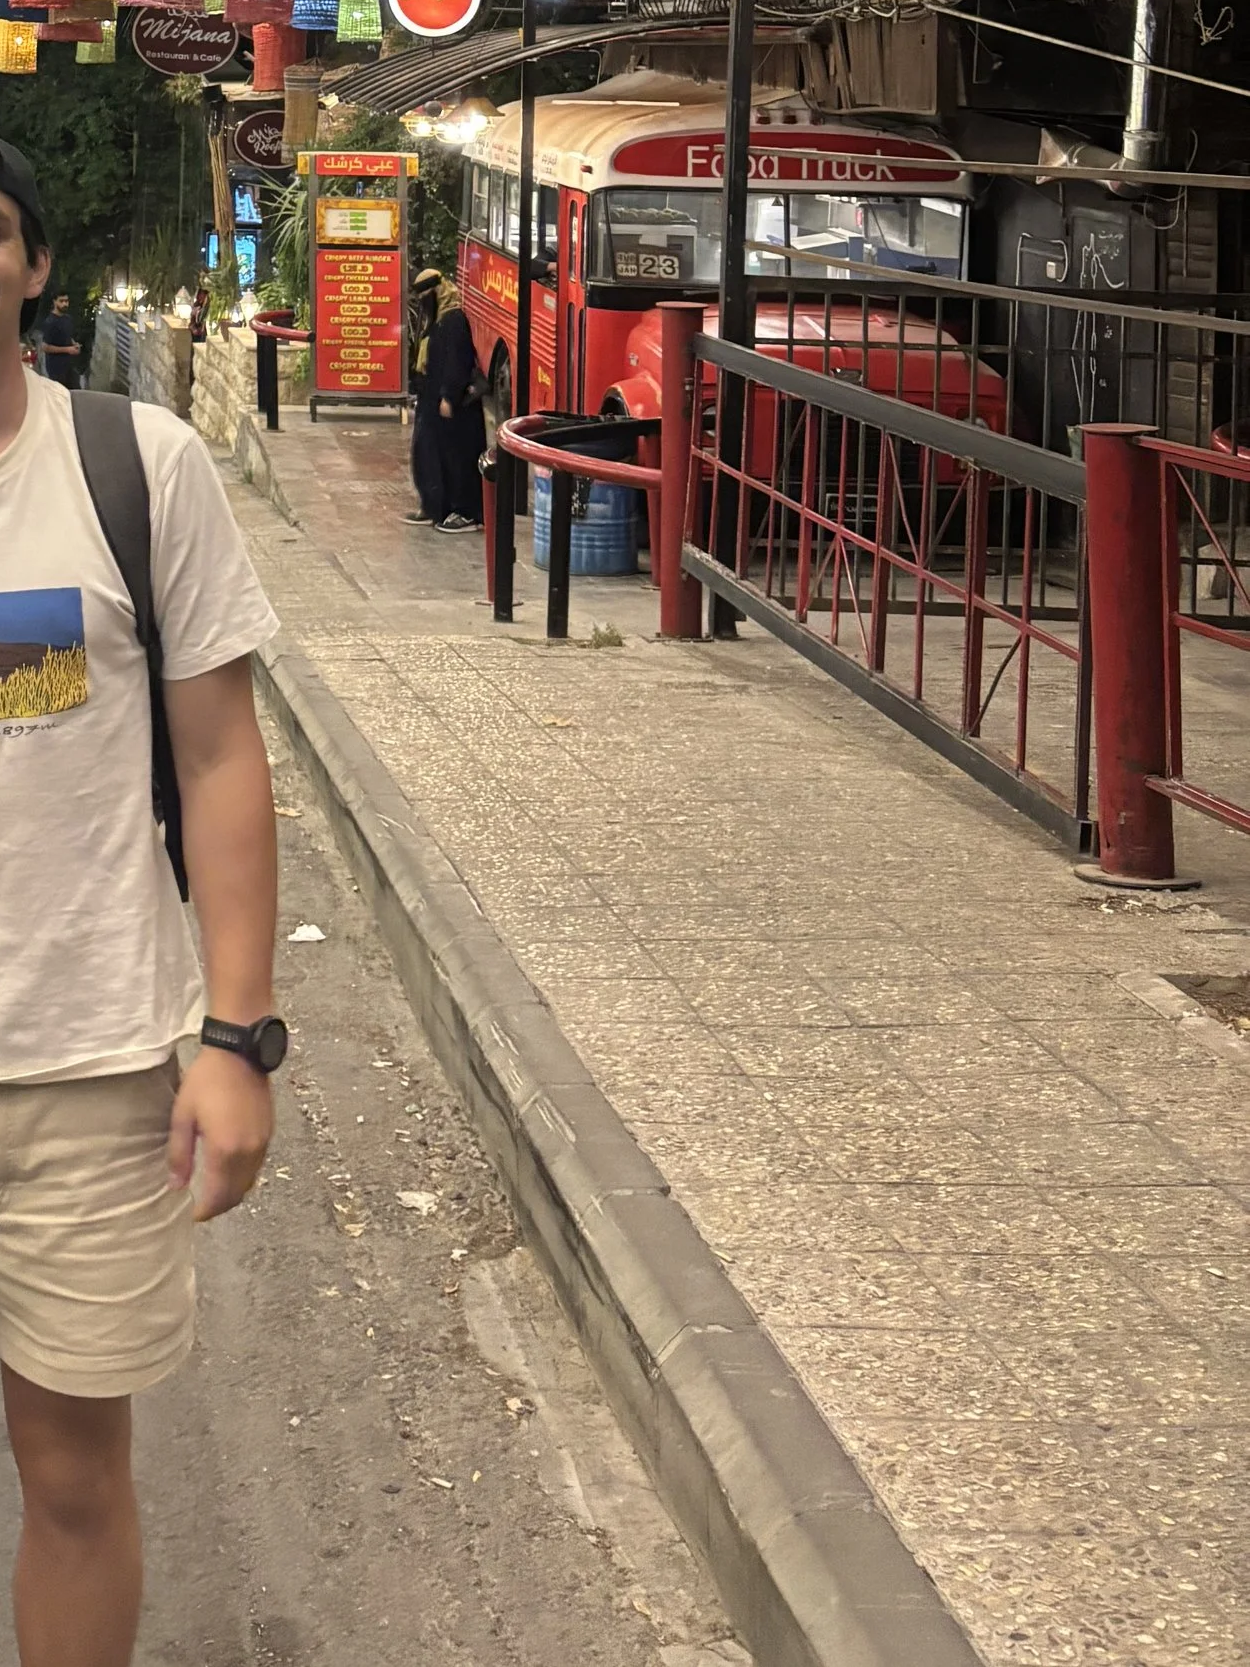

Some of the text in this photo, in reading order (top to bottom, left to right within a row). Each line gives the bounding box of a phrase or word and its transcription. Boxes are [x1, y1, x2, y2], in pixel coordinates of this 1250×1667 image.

[139, 18, 233, 48] Mijana
[145, 50, 191, 61] Restauran
[686, 144, 896, 182] Fod Truck
[642, 256, 677, 276] 23
